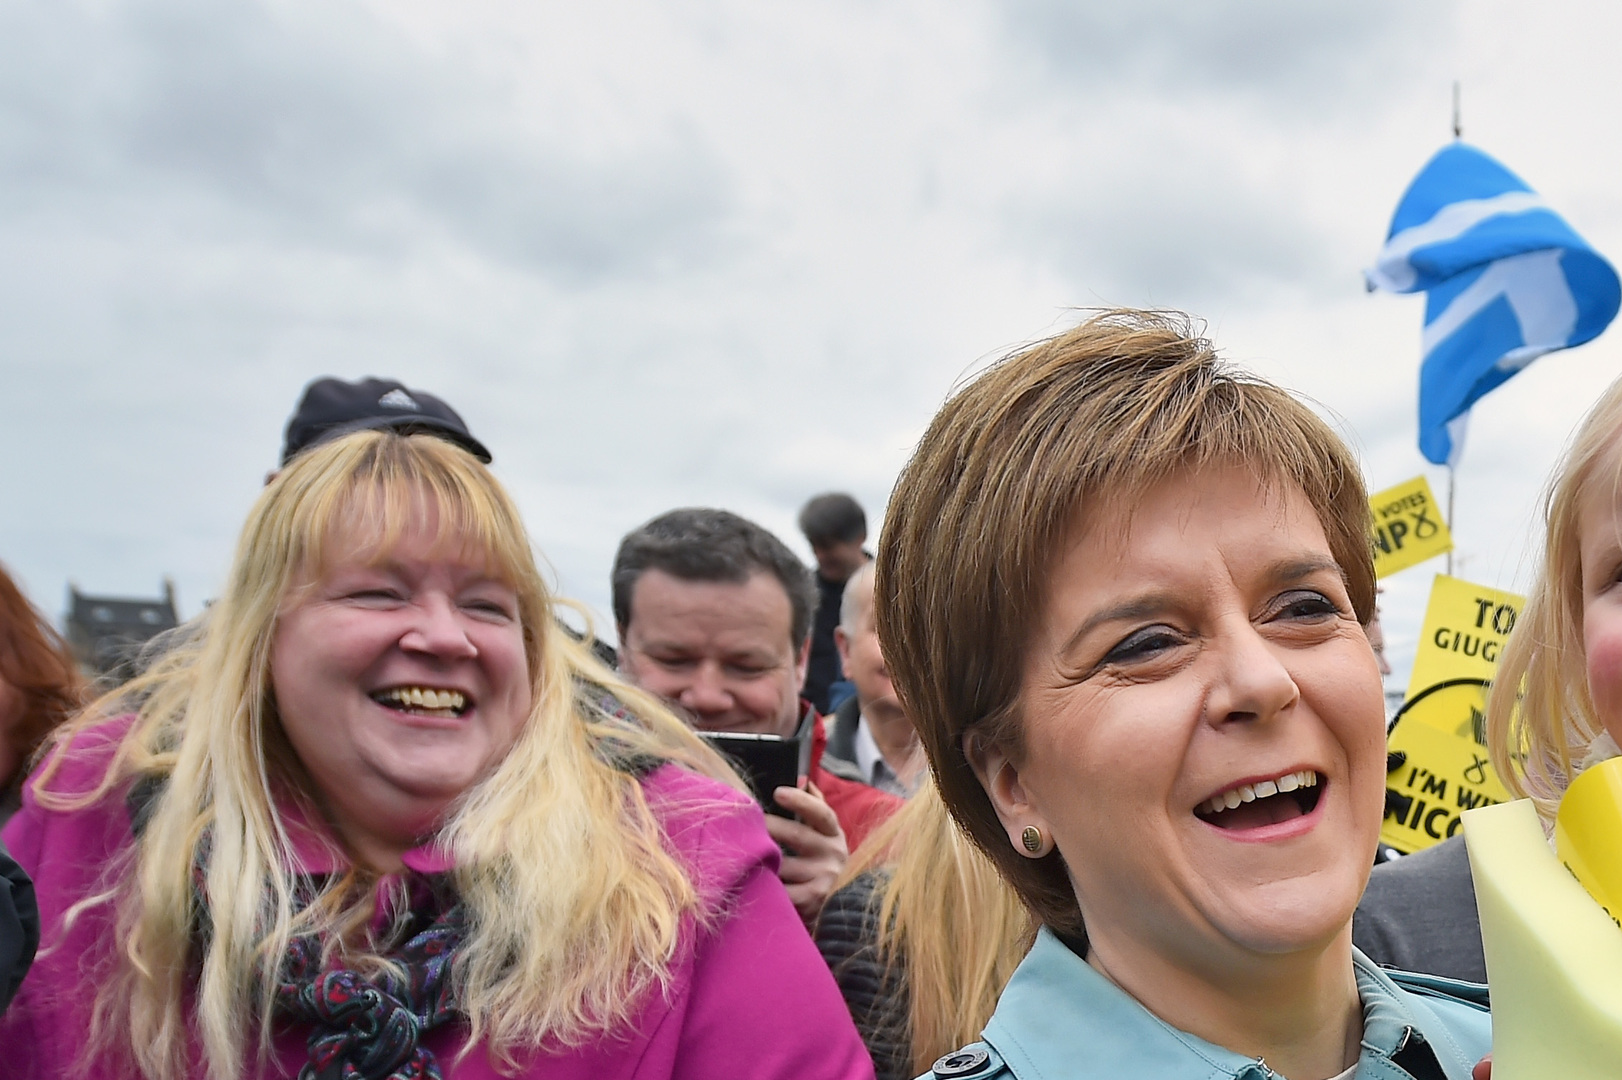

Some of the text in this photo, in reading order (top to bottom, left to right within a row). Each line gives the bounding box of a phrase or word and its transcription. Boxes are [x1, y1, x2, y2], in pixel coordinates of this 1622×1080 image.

[1475, 598, 1516, 635] TO
[1434, 627, 1503, 663] GIUG
[1407, 767, 1448, 800] I'M
